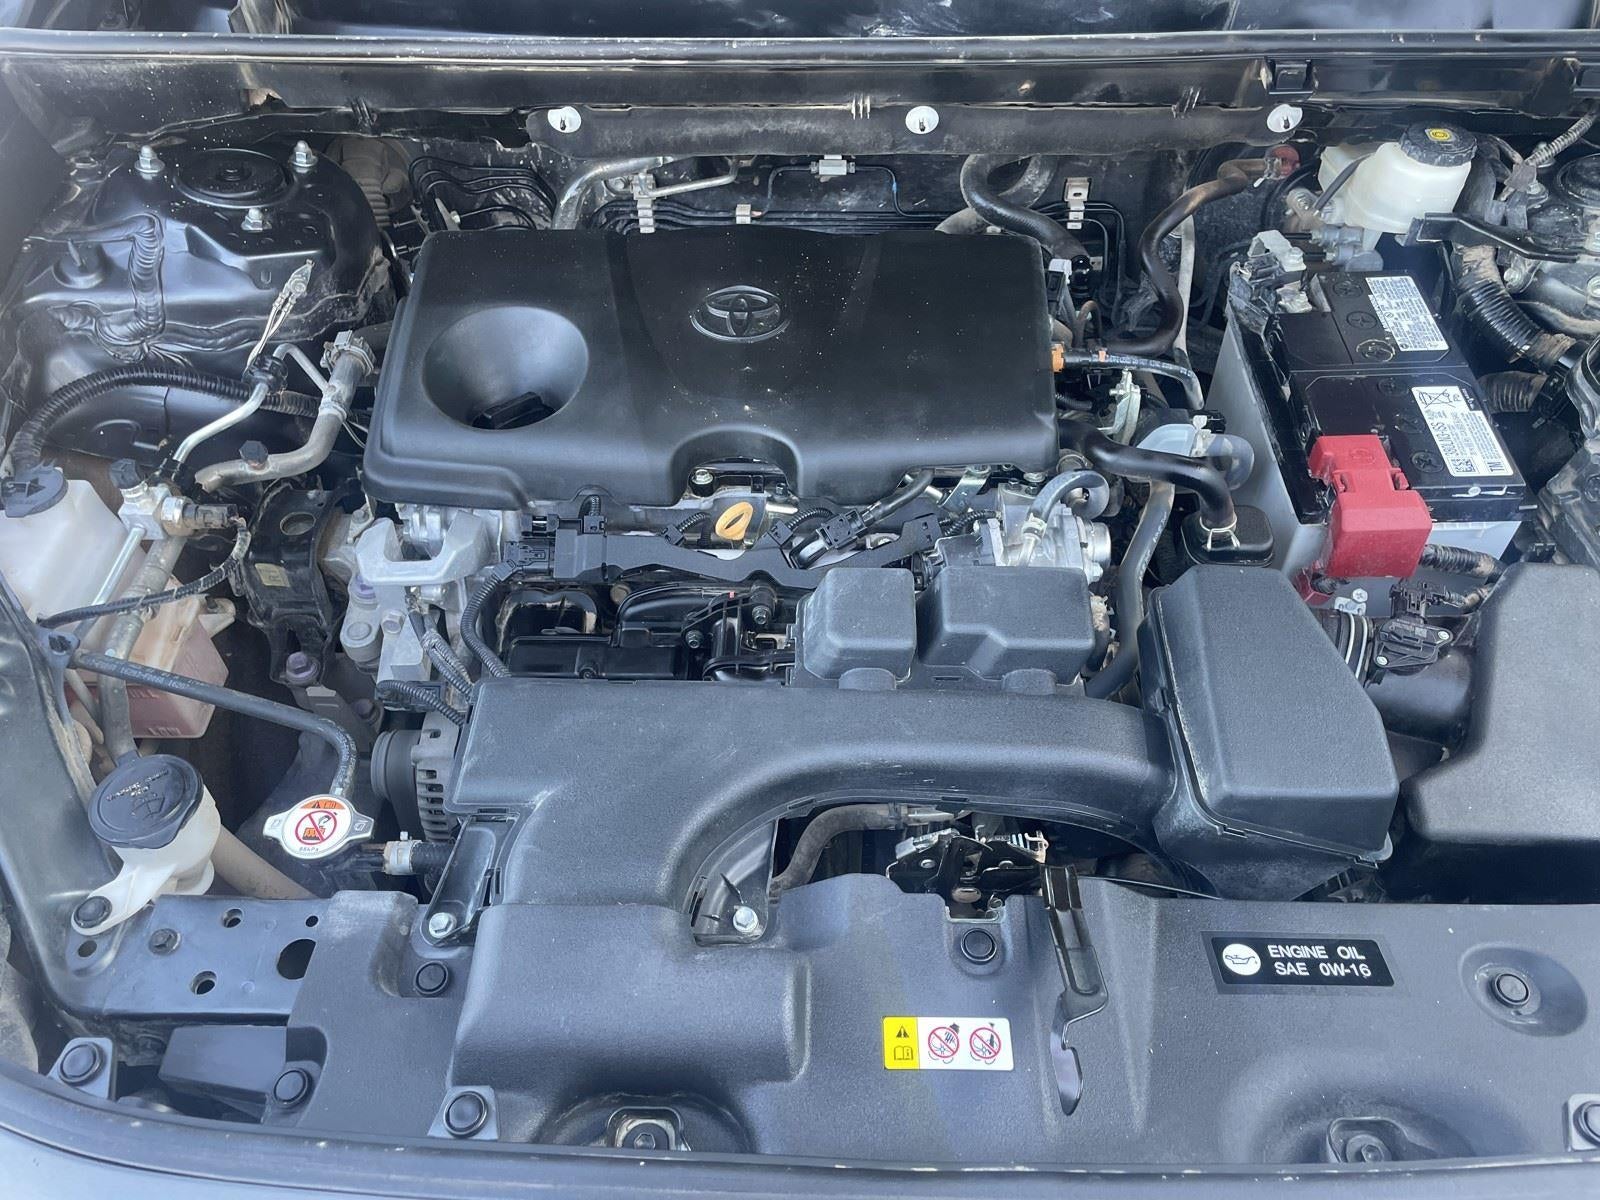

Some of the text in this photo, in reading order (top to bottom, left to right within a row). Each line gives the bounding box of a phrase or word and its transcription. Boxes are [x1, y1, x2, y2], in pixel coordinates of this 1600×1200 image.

[1487, 461, 1505, 472] TM
[1267, 944, 1366, 960] ENGINE OIL
[1274, 962, 1372, 977] SAE 0W-16
